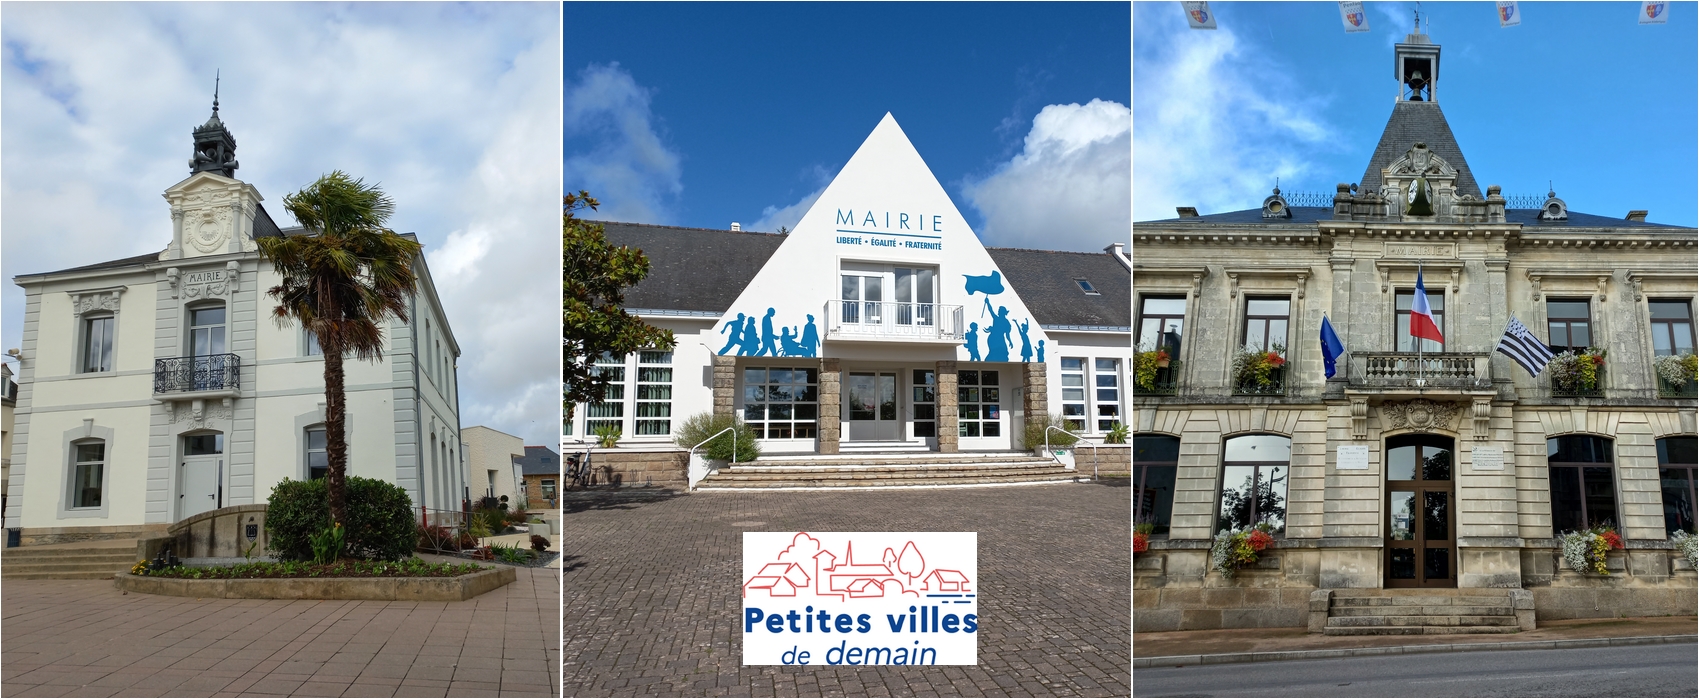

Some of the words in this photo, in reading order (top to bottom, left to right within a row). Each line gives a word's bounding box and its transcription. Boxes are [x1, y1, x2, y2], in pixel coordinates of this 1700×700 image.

[836, 208, 942, 231] MAIRIE
[836, 236, 862, 245] LIBERTÉ
[871, 237, 896, 247] ÉGALITÉ
[905, 240, 942, 250] FRATERNITÉ
[1395, 246, 1444, 256] MAIRIE
